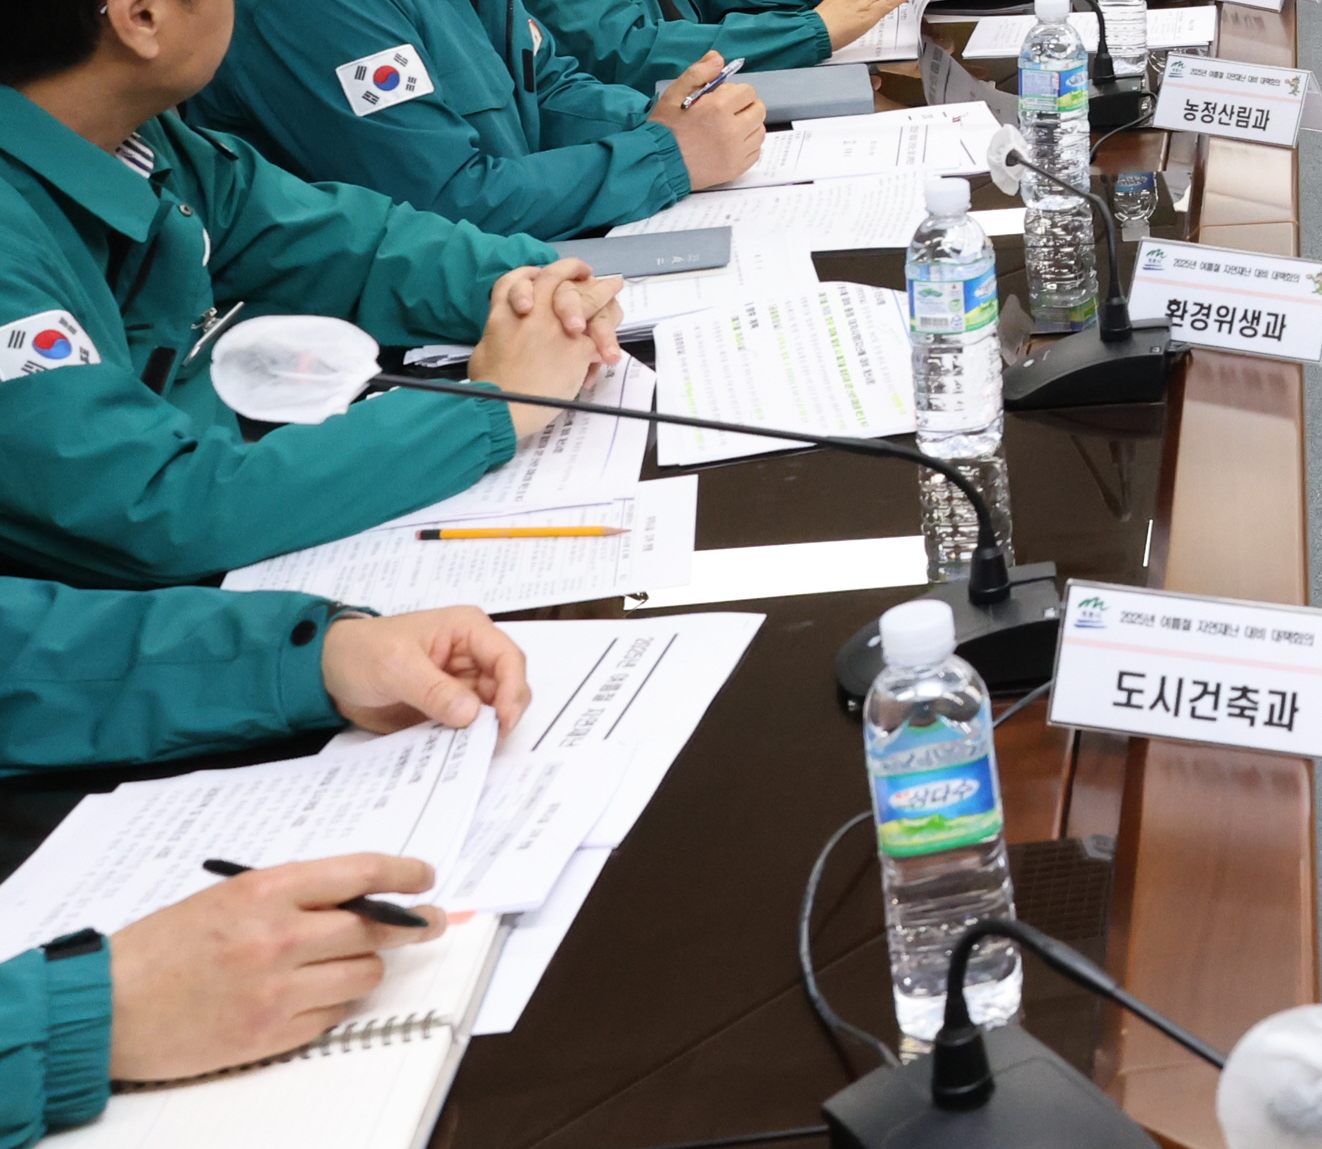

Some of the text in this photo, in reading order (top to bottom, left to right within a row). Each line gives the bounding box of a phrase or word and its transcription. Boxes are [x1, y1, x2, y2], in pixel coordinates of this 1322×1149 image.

[1183, 98, 1270, 132] 농정산림과
[1165, 298, 1287, 342] 환경위생과
[1119, 609, 1315, 647] 2025년 여름철 자연재난 대비 대책회의
[1112, 670, 1300, 733] 도시건축과
